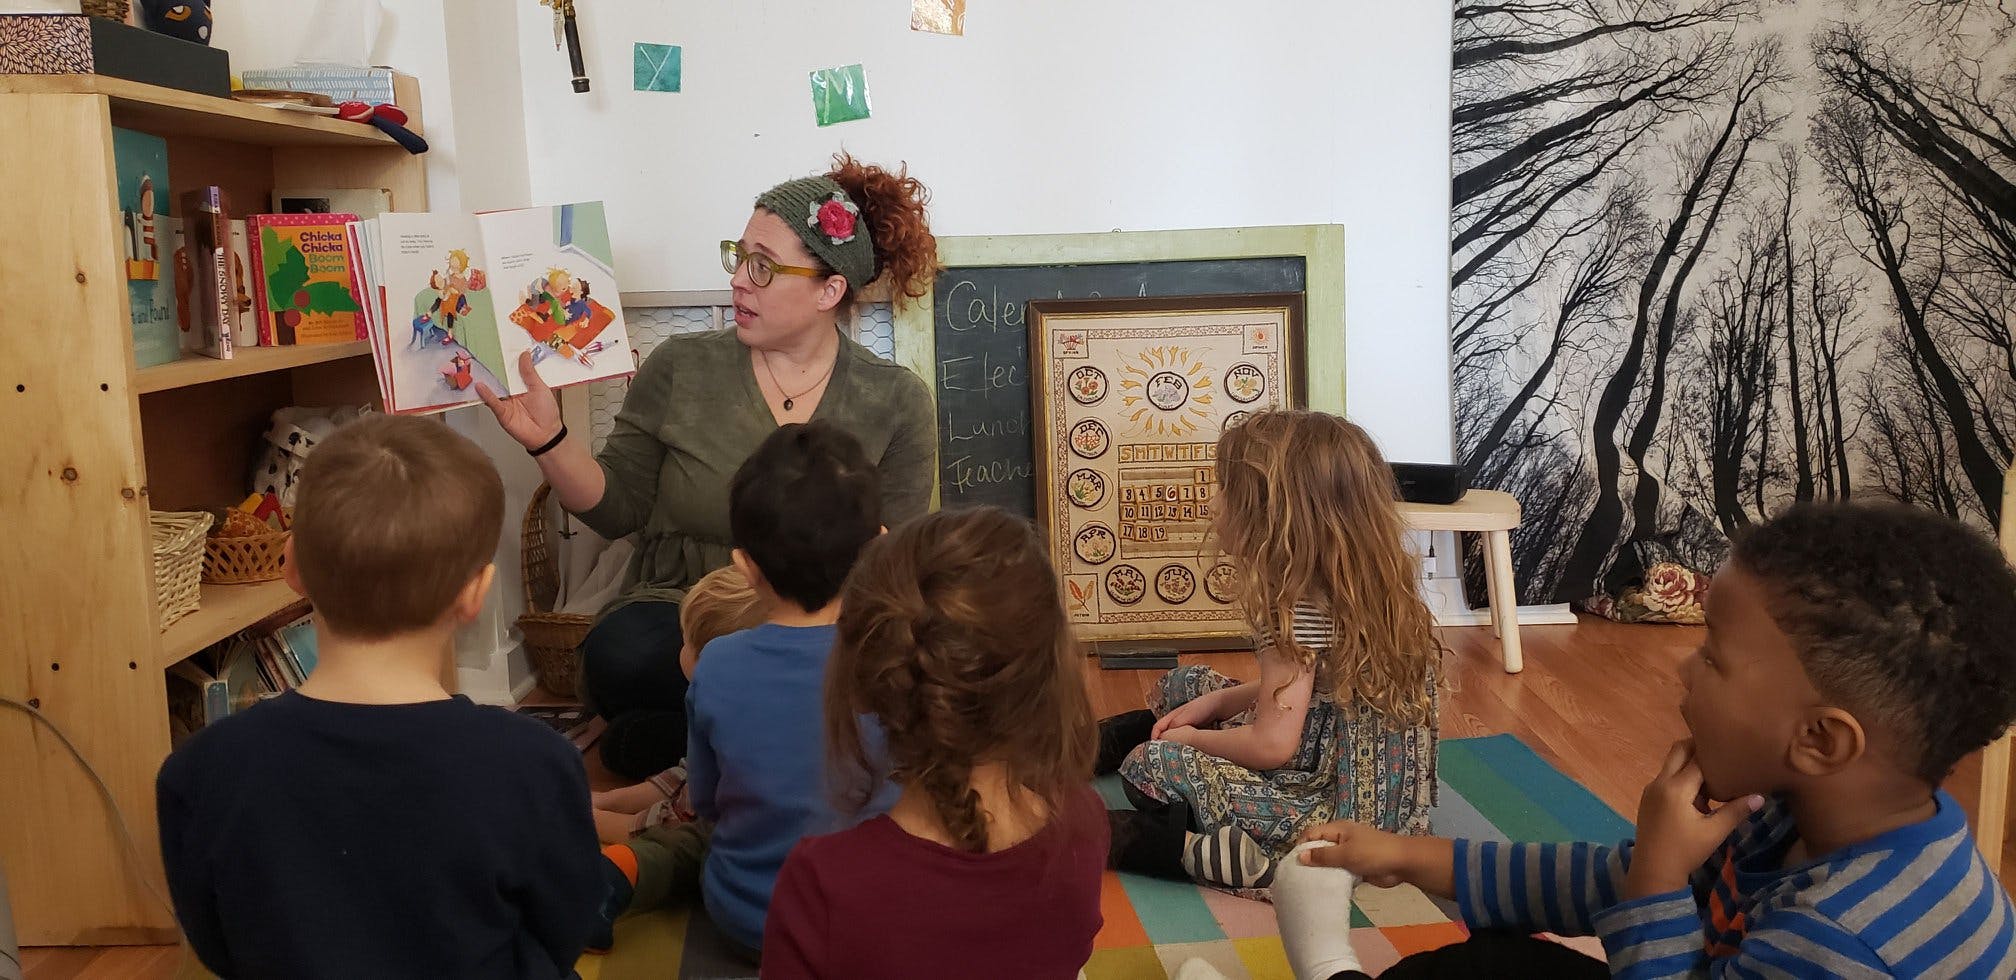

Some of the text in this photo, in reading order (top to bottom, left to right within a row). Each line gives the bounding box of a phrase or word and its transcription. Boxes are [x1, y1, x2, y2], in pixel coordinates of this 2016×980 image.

[300, 231, 342, 242] Chicka
[301, 242, 343, 254] Chicka
[217, 252, 225, 267] THE
[309, 254, 344, 263] Boom
[310, 264, 345, 273] Boom
[219, 270, 229, 307] SNOWY
[947, 281, 1027, 333] Cale
[222, 308, 231, 326] DAY
[1076, 368, 1102, 380] OCT
[1234, 367, 1259, 379] NOV
[1155, 376, 1182, 390] FEB
[1079, 422, 1104, 437] DEC
[1076, 472, 1101, 491] MAR
[1126, 486, 1206, 500] 3 4 5 6 7 8
[1124, 505, 1209, 518] 10 11 12 13 14 15
[1080, 528, 1107, 543] APR
[1123, 525, 1165, 539] 17 18 19
[1112, 569, 1142, 583] MAY
[1164, 568, 1190, 581] JUL
